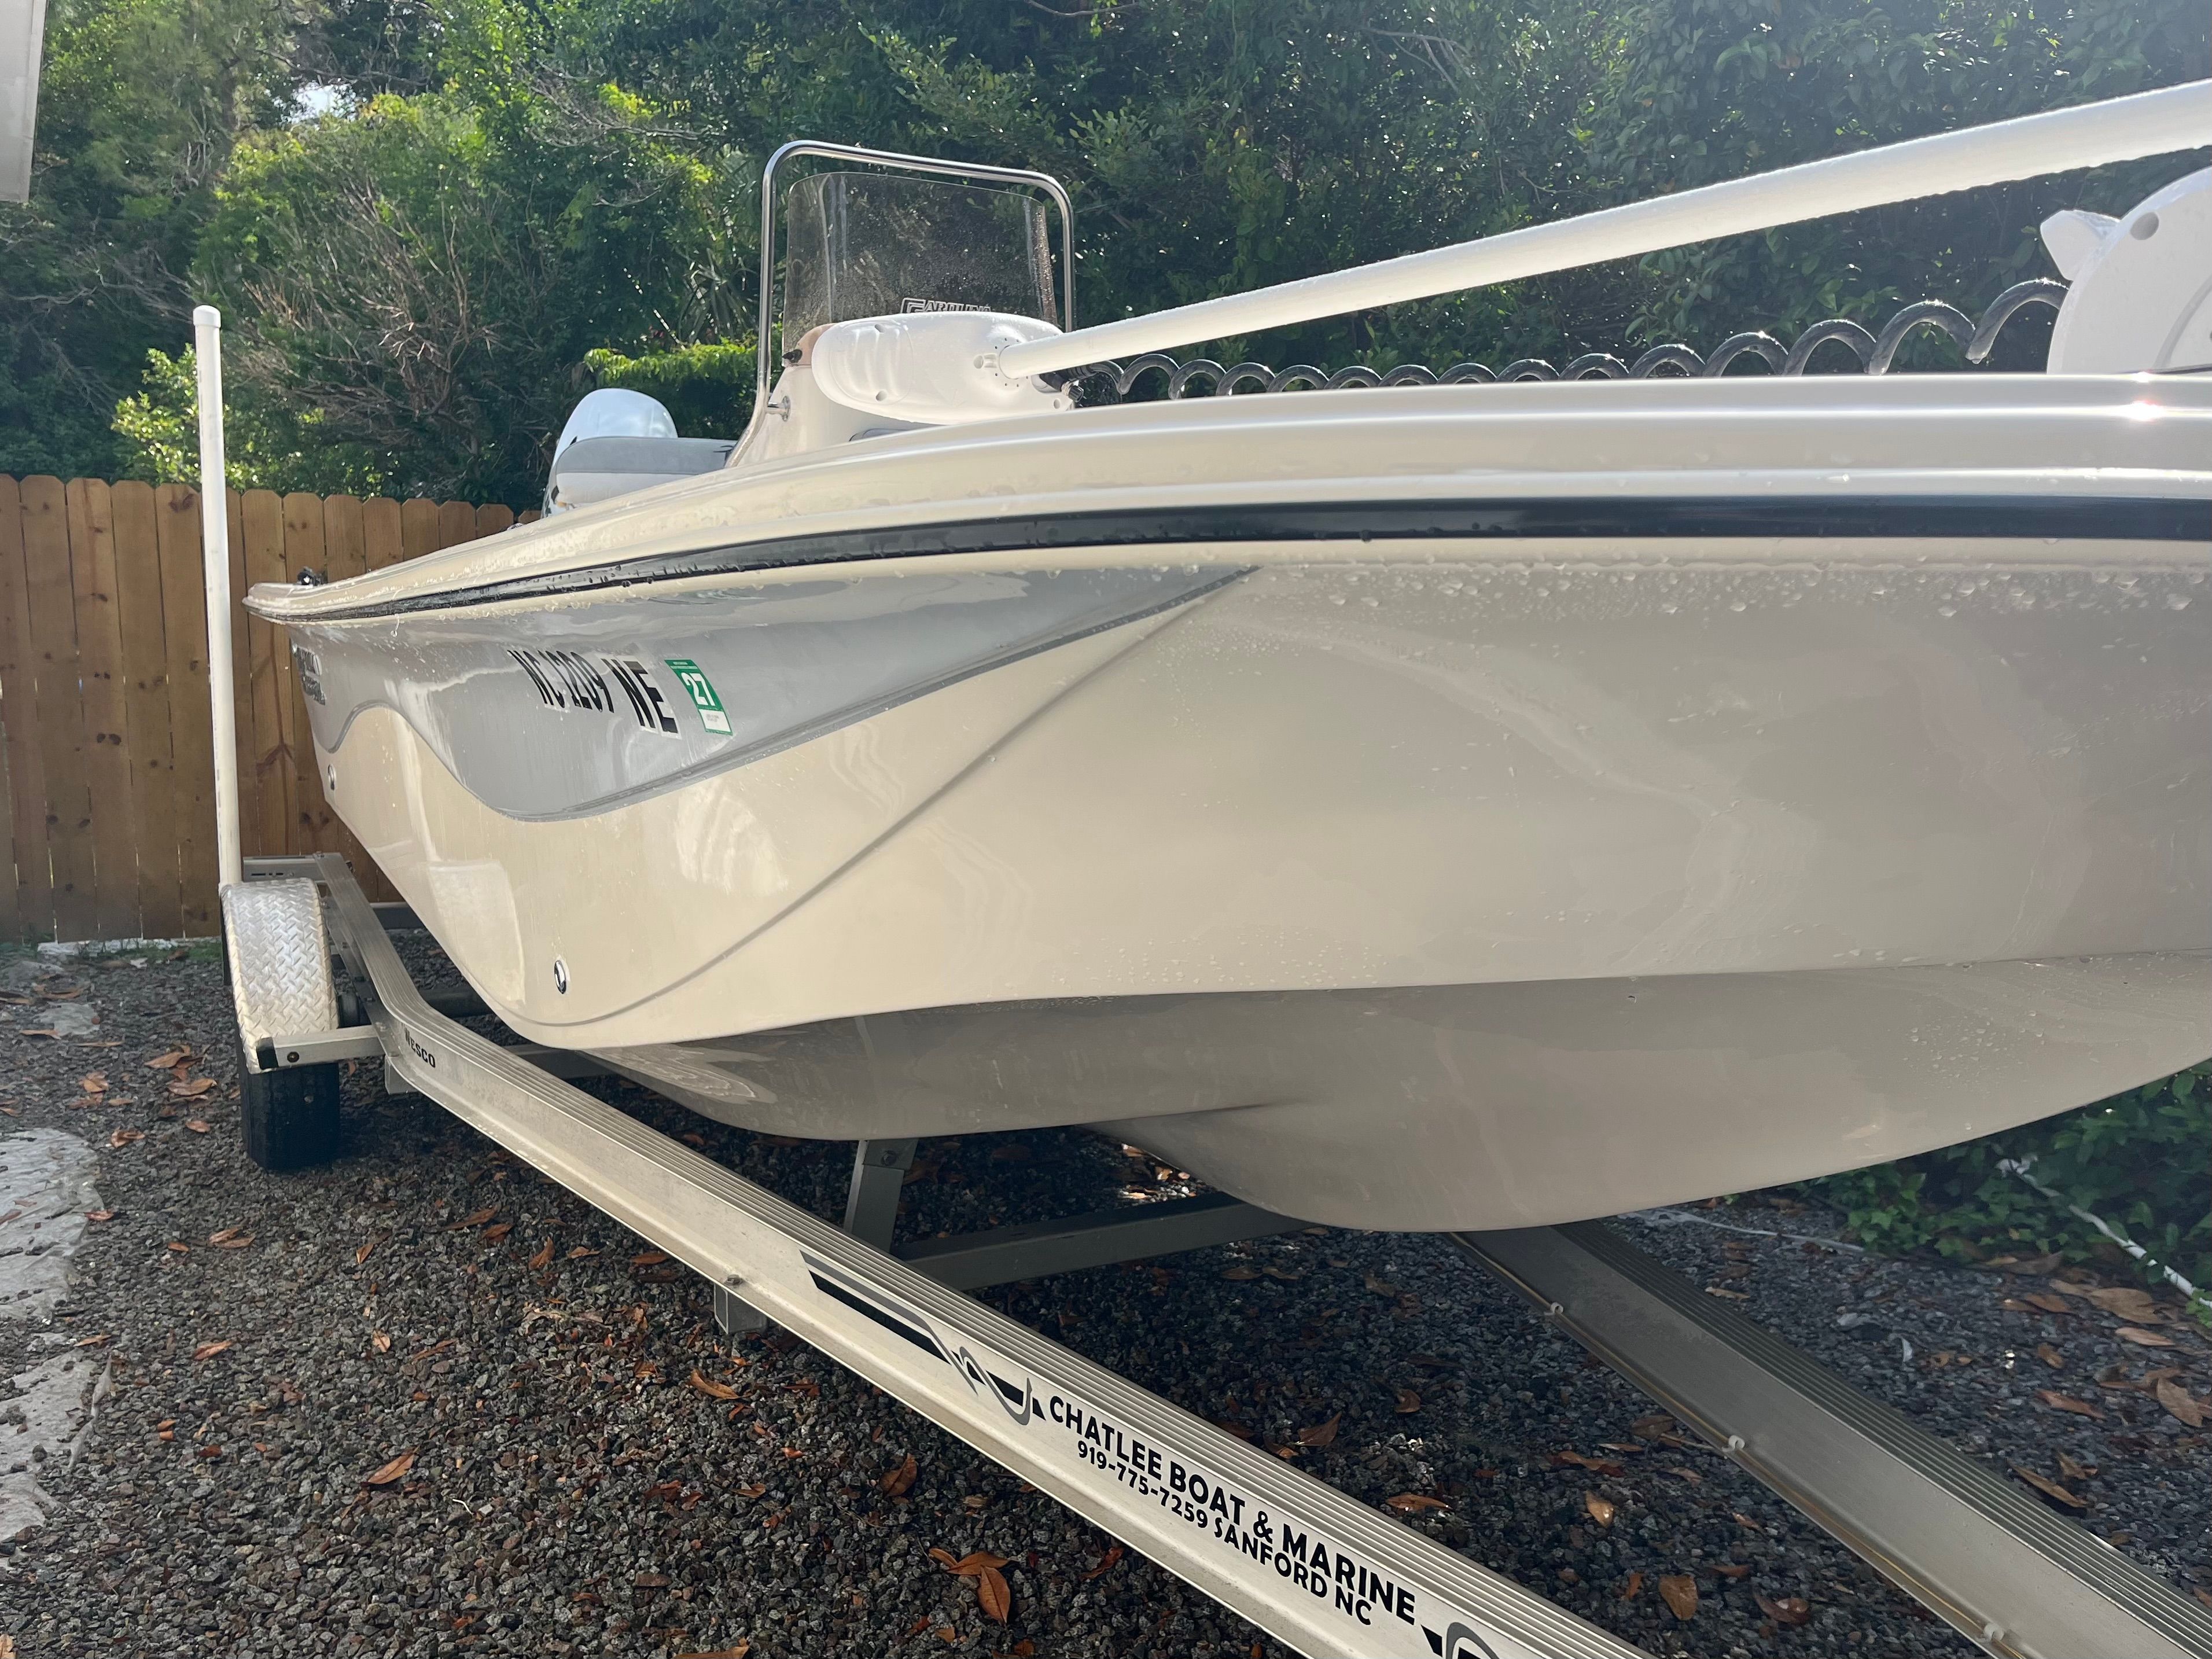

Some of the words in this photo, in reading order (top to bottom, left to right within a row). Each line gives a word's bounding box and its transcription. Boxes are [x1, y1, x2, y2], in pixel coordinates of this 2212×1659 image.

[507, 649, 565, 708] NC
[538, 649, 615, 713] 1209
[600, 658, 679, 734] NE
[680, 672, 716, 707] 27
[1050, 1396, 1162, 1481] CHATLEE
[1169, 1461, 1246, 1526] BOAT
[1253, 1510, 1273, 1543] &
[1283, 1523, 1416, 1625] MARINE
[1077, 1440, 1208, 1528] 919-775-7259
[1214, 1517, 1328, 1598] SANFORD
[1335, 1586, 1372, 1626] NC
